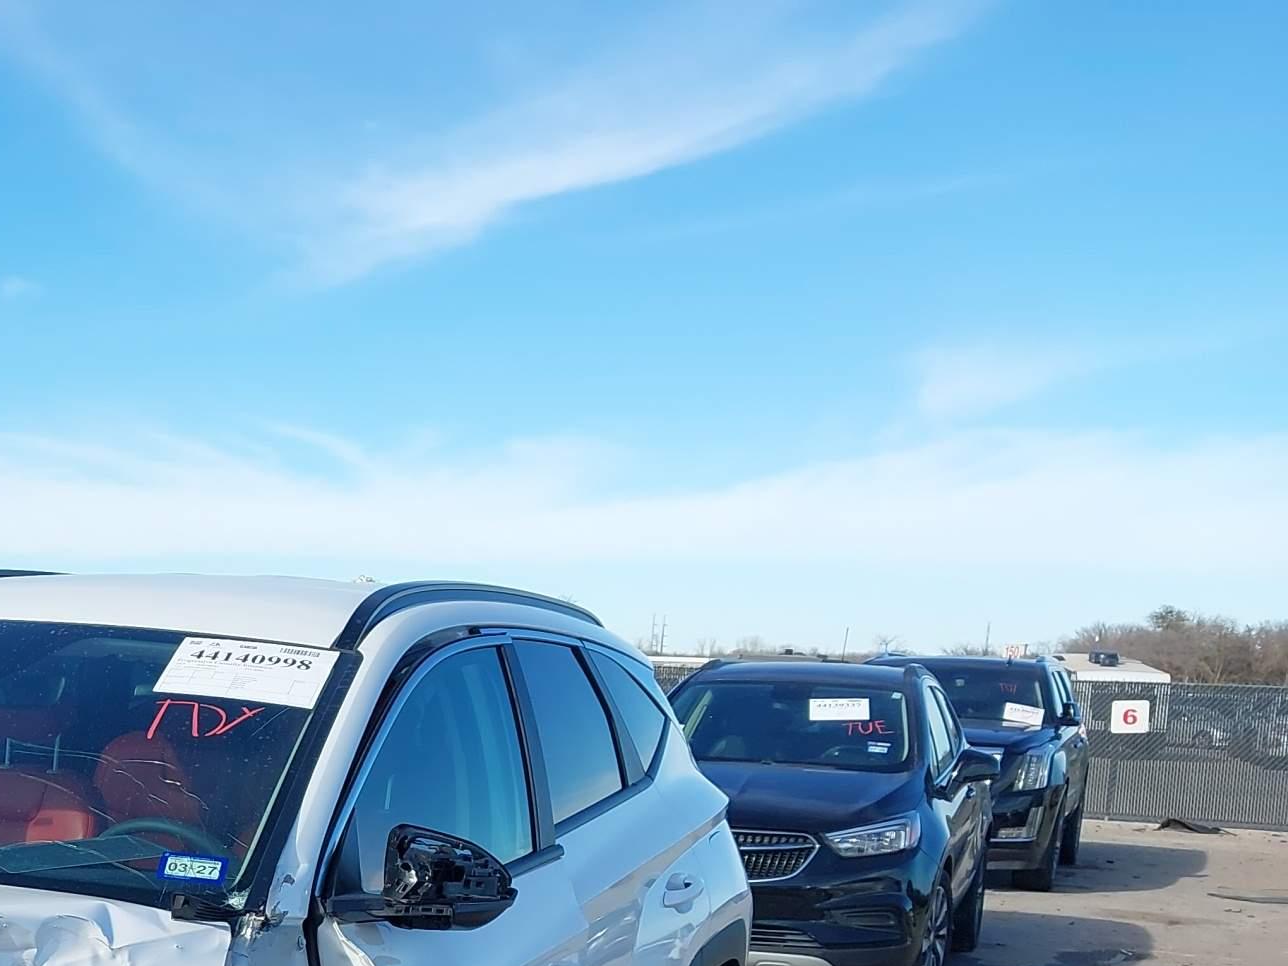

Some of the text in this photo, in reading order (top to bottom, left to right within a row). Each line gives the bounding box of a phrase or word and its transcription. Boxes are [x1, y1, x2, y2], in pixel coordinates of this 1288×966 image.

[190, 649, 312, 670] 44140998
[1123, 709, 1137, 725] 6
[842, 720, 894, 735] TUE
